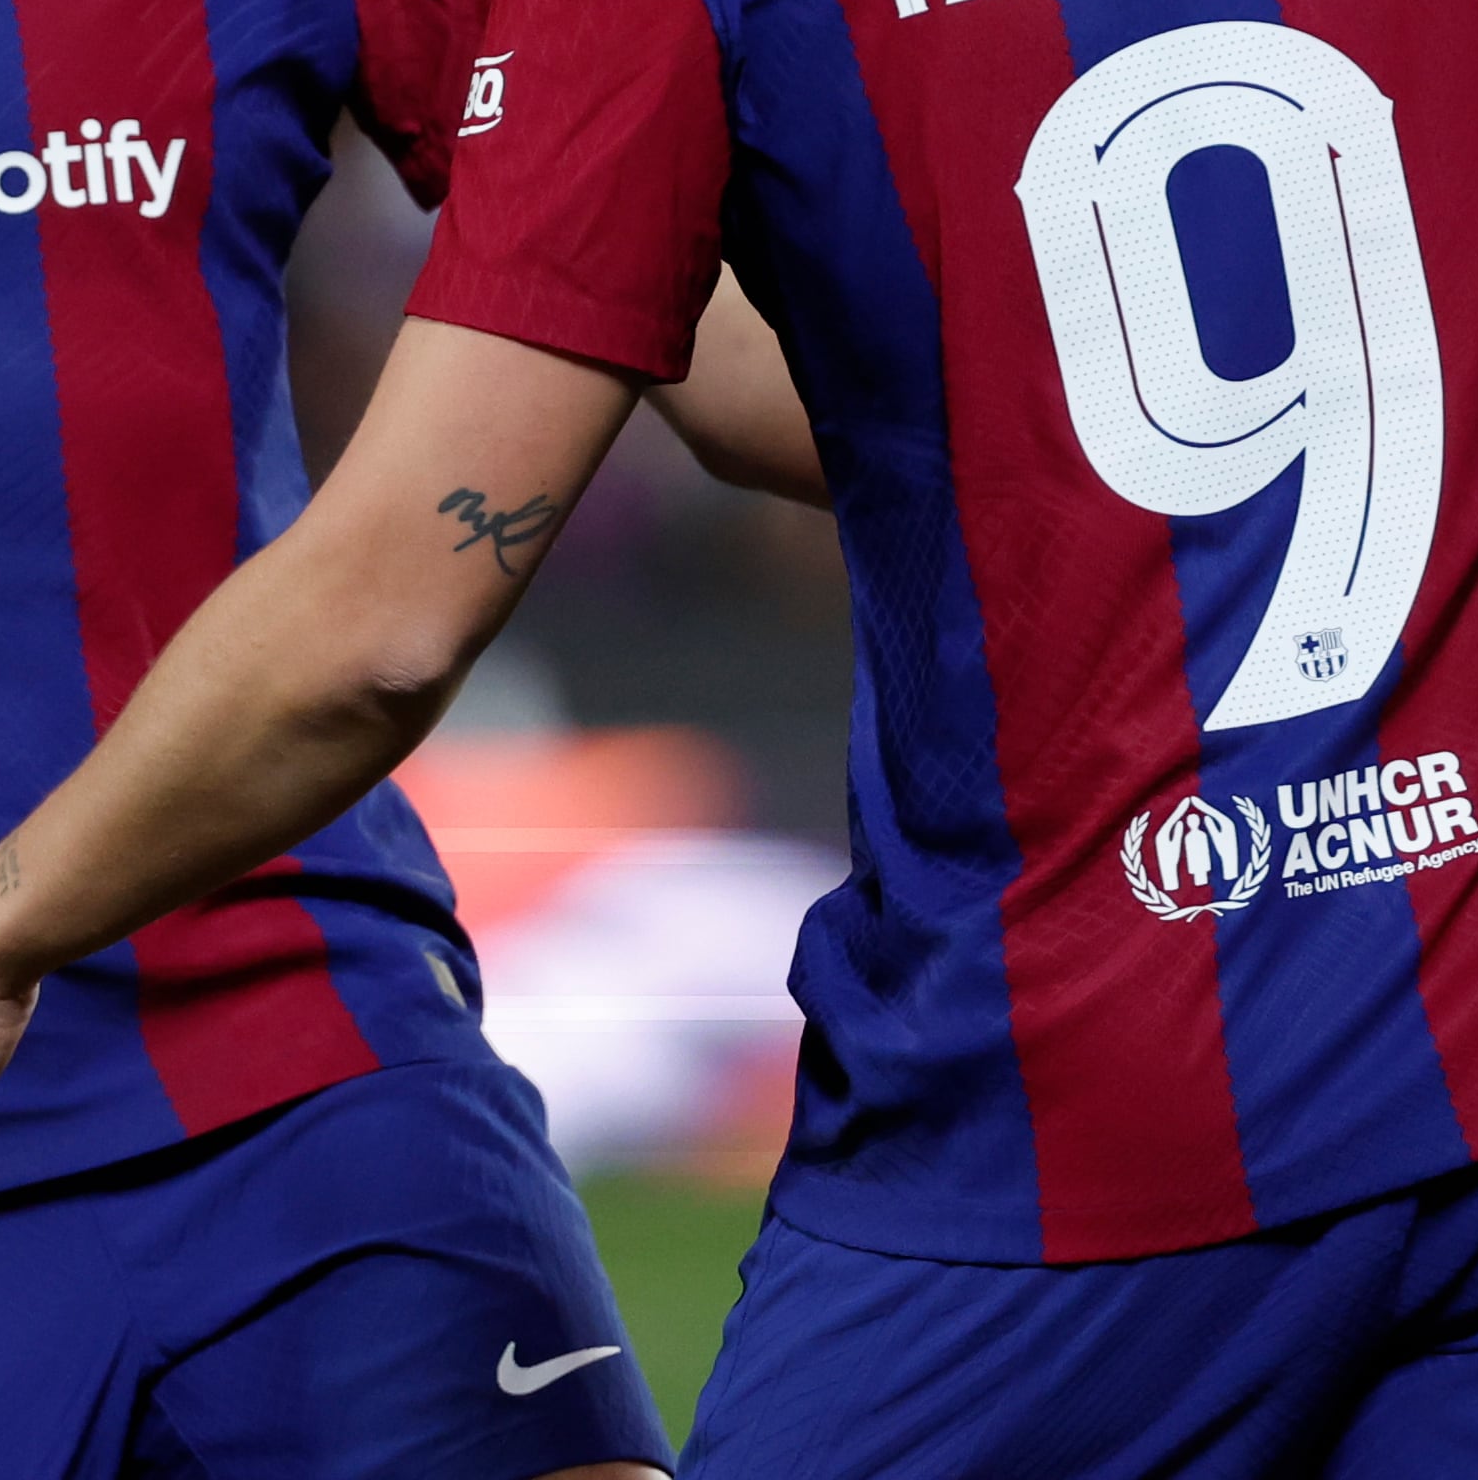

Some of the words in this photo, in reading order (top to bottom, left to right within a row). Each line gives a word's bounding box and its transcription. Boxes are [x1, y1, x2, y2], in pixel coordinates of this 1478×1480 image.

[1013, 20, 1444, 732] 9
[1277, 751, 1468, 829] UNHCR
[1284, 881, 1313, 898] The
[1314, 873, 1340, 893] UN
[1341, 862, 1416, 888] Refugee
